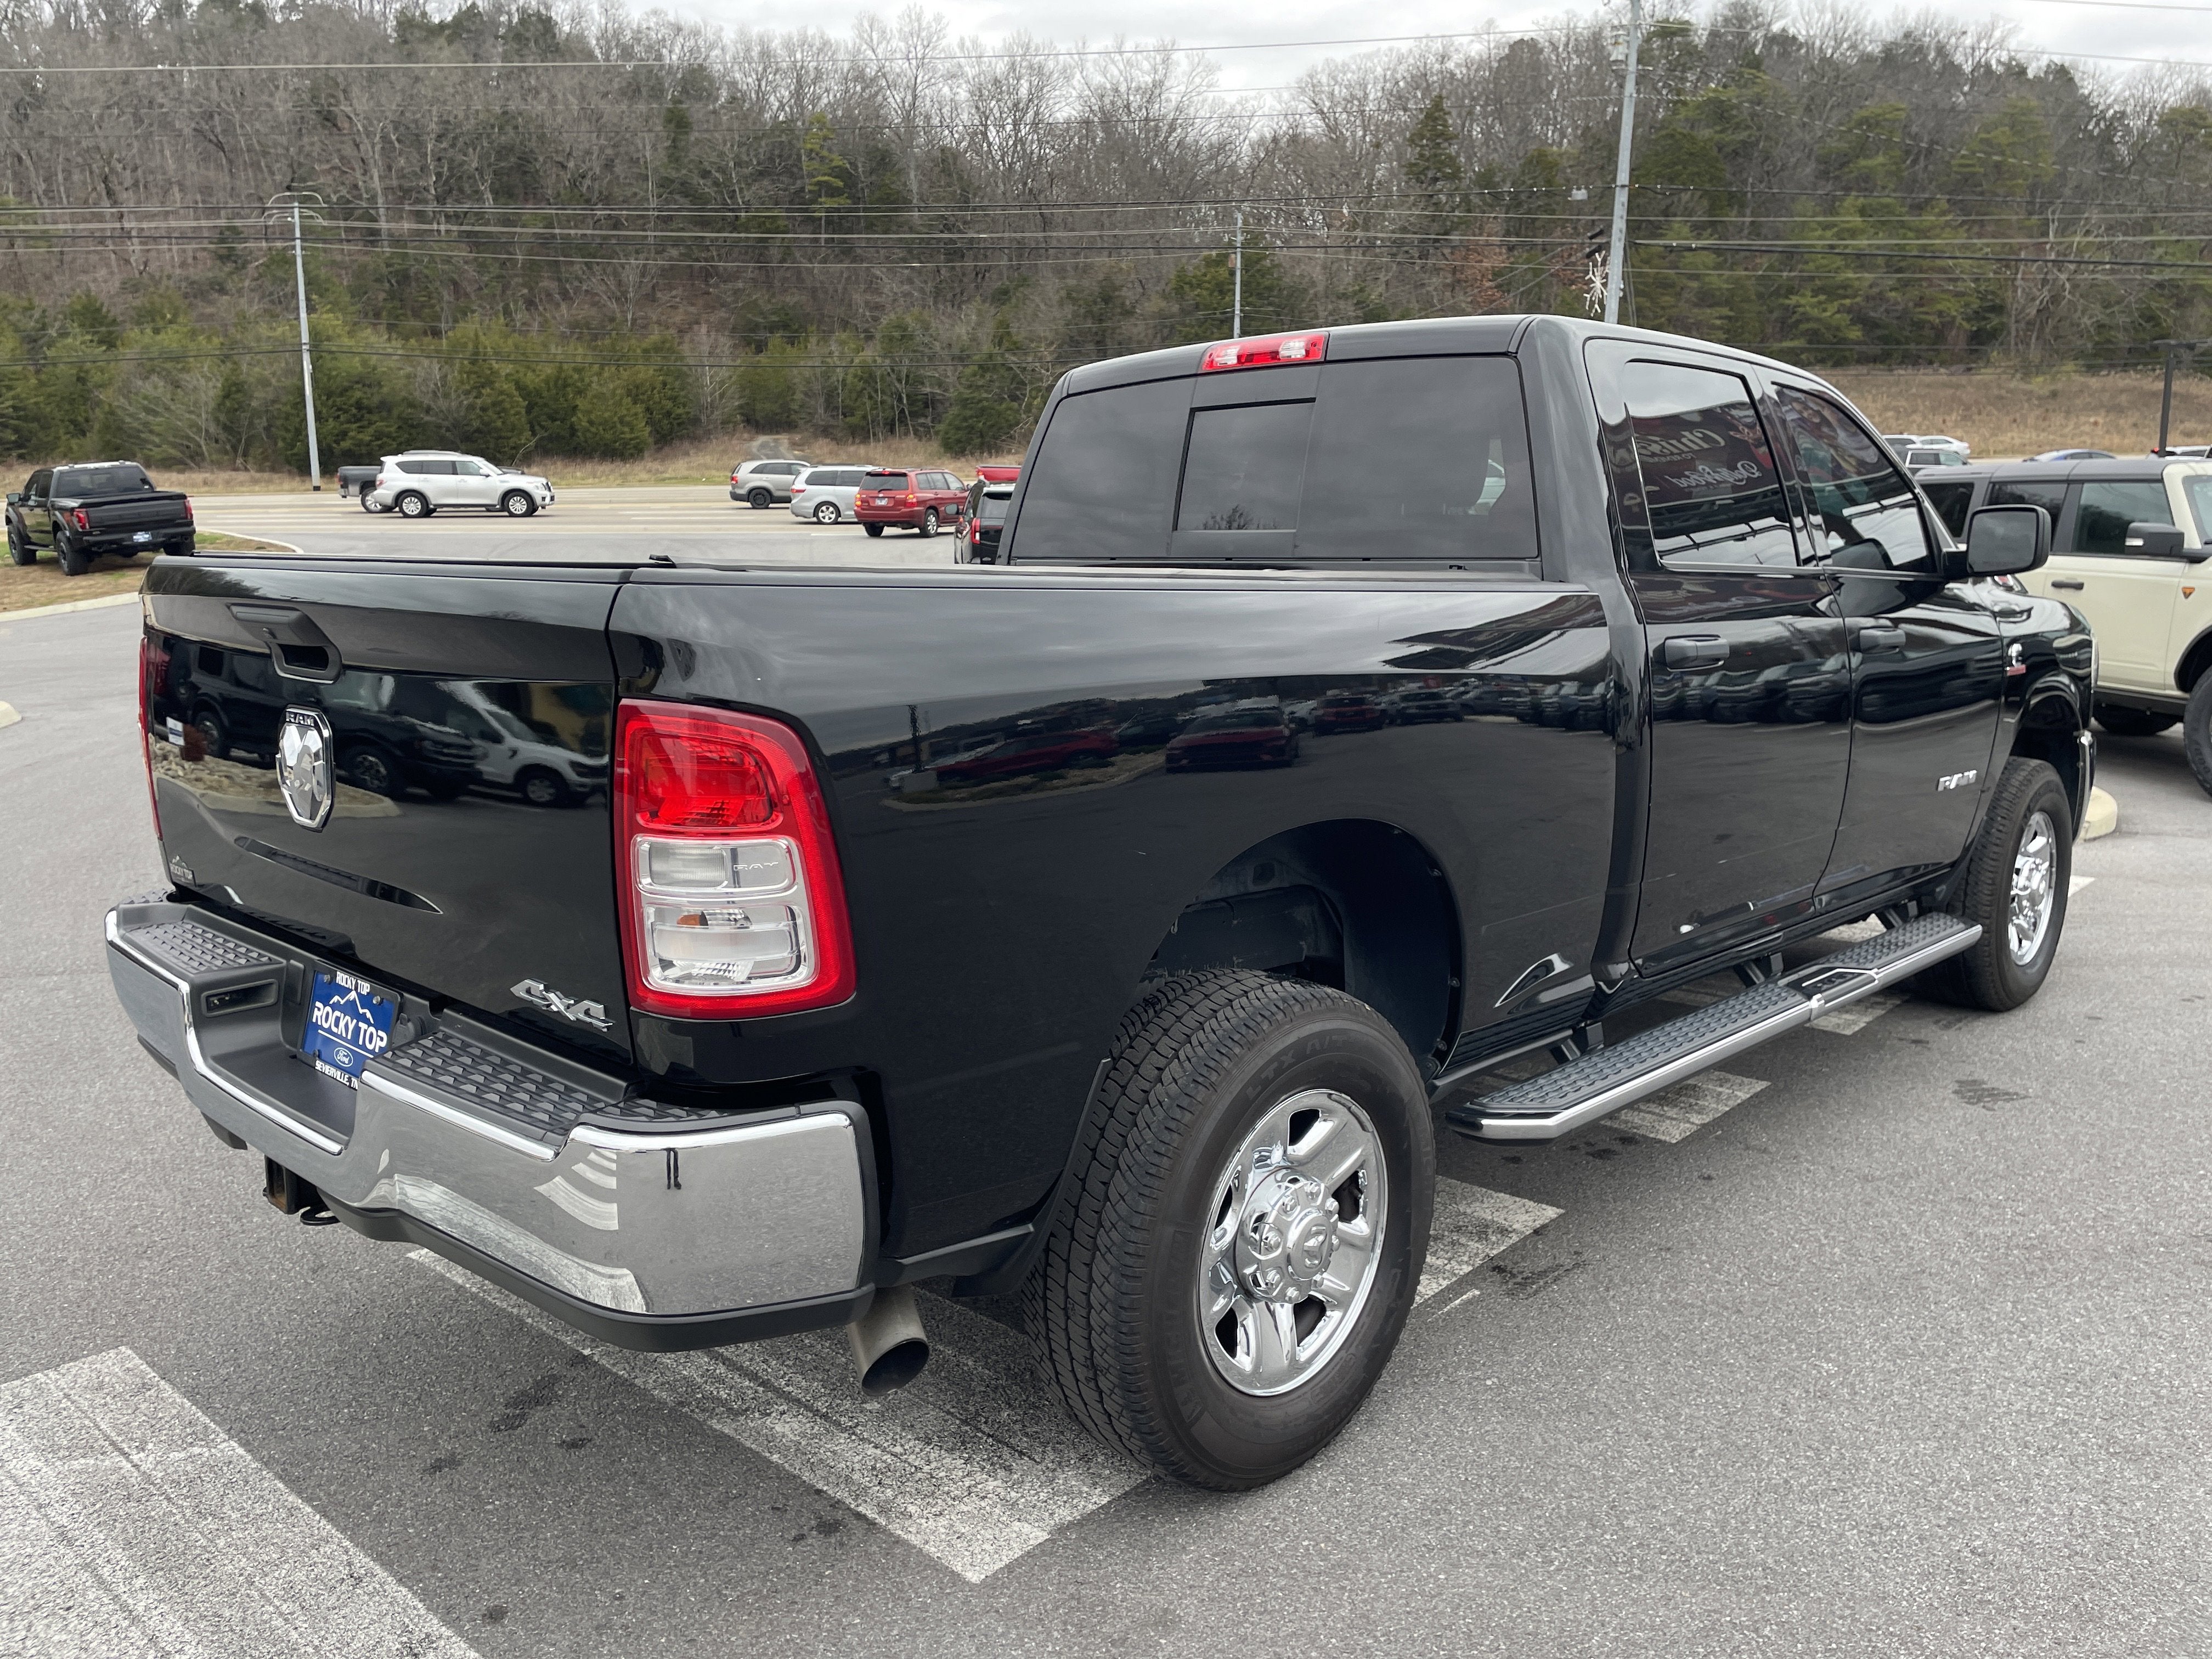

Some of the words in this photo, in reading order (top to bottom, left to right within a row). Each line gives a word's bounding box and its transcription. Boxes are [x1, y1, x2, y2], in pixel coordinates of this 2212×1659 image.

[286, 712, 314, 726] RAM
[1938, 769, 1977, 792] RAM
[336, 971, 356, 990] ROCKY
[357, 980, 370, 996] TOP
[312, 1001, 357, 1040] ROCKY
[358, 1022, 387, 1053] TOP
[337, 1049, 349, 1064] Ford
[315, 1060, 349, 1086] SEVIERVILLE,
[351, 1077, 358, 1090] TN
